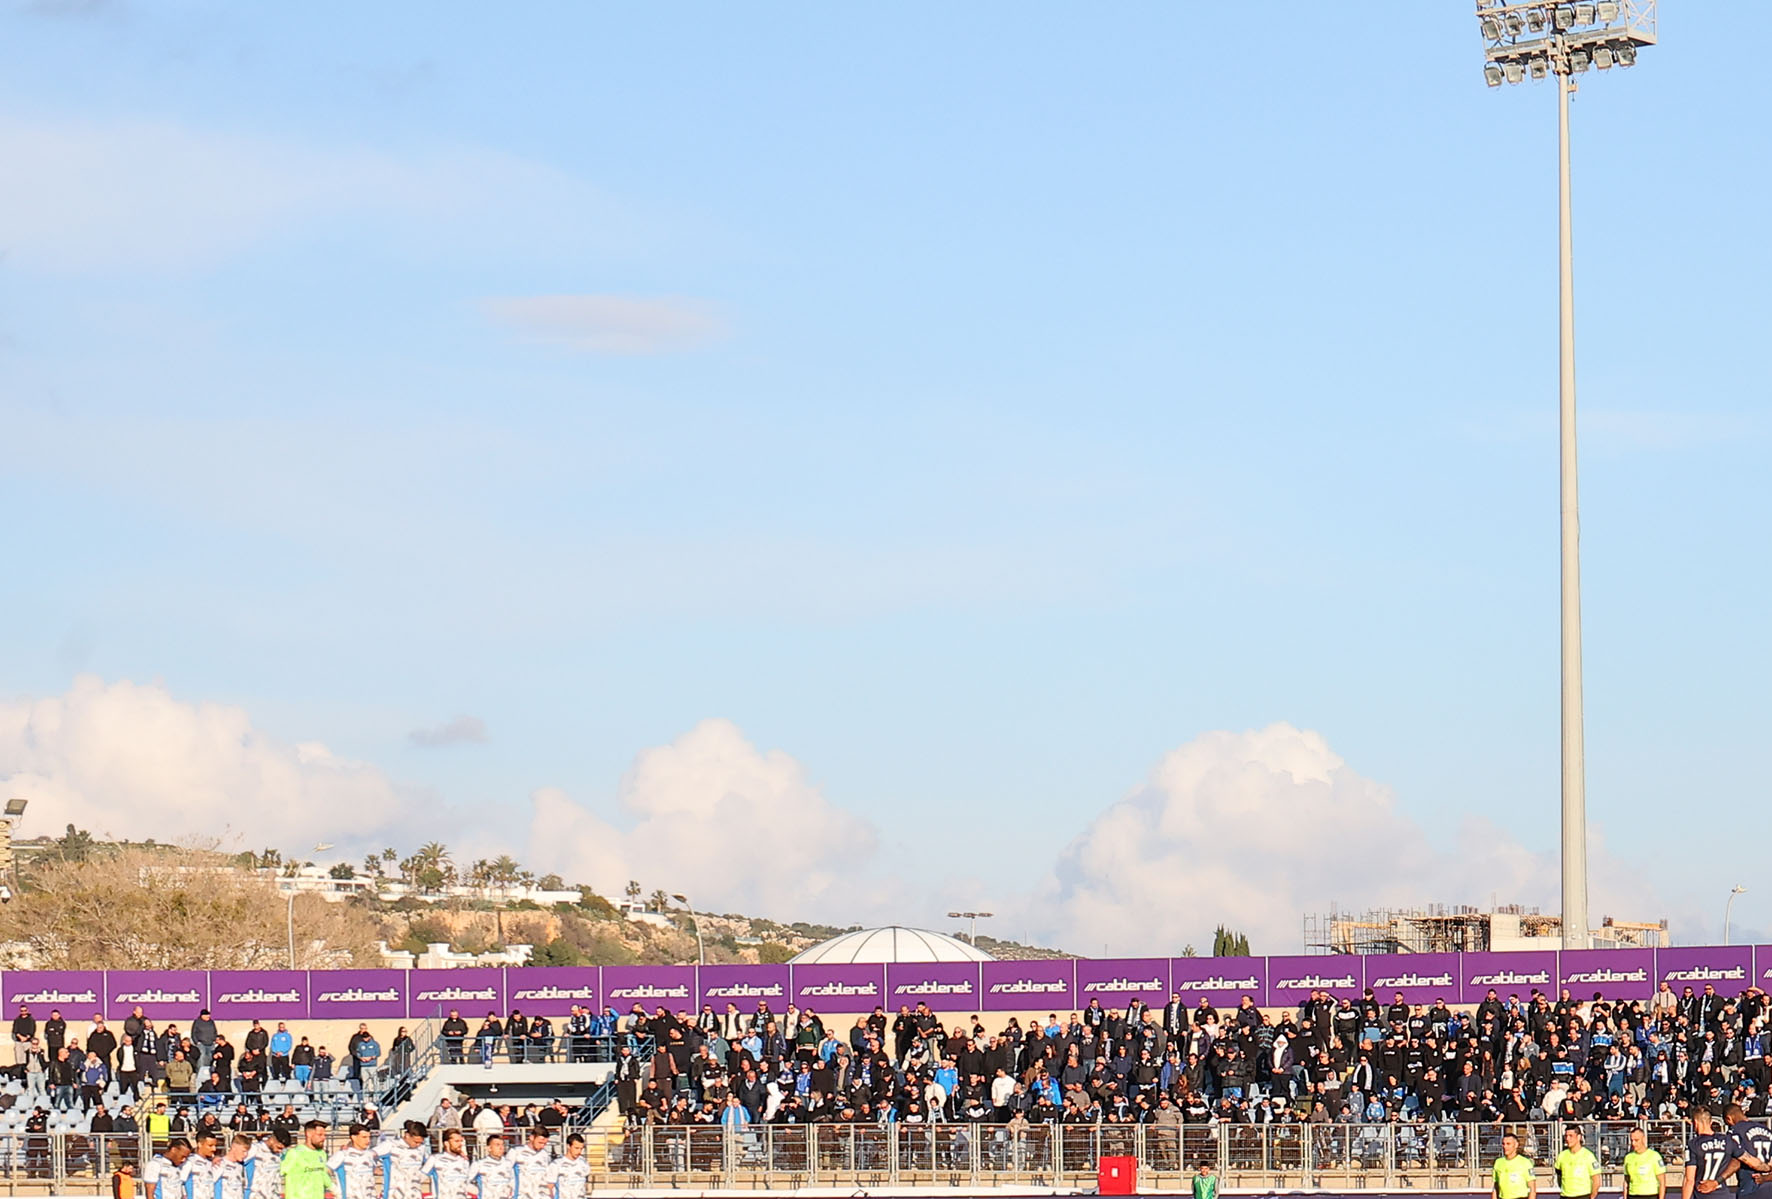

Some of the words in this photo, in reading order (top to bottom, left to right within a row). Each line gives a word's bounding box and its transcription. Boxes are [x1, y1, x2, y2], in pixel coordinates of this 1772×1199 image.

[1384, 973, 1452, 988] cablenet
[1481, 971, 1550, 985] cablenet
[1578, 969, 1647, 983] cablenet
[1676, 966, 1745, 981] cablenet
[810, 982, 877, 996] cablenet
[904, 981, 972, 995] cablenet
[999, 979, 1067, 994] cablenet
[1094, 978, 1162, 993] cablenet
[1190, 976, 1258, 990] cablenet
[1286, 975, 1355, 989] cablenet
[23, 988, 97, 1003] cablenet
[126, 988, 200, 1003] cablenet
[228, 988, 300, 1003] cablenet
[329, 987, 399, 1002] cablenet
[427, 987, 496, 1001] cablenet
[524, 986, 593, 1001] cablenet
[620, 984, 689, 999] cablenet
[716, 983, 783, 997] cablenet
[1703, 1152, 1726, 1181] 17
